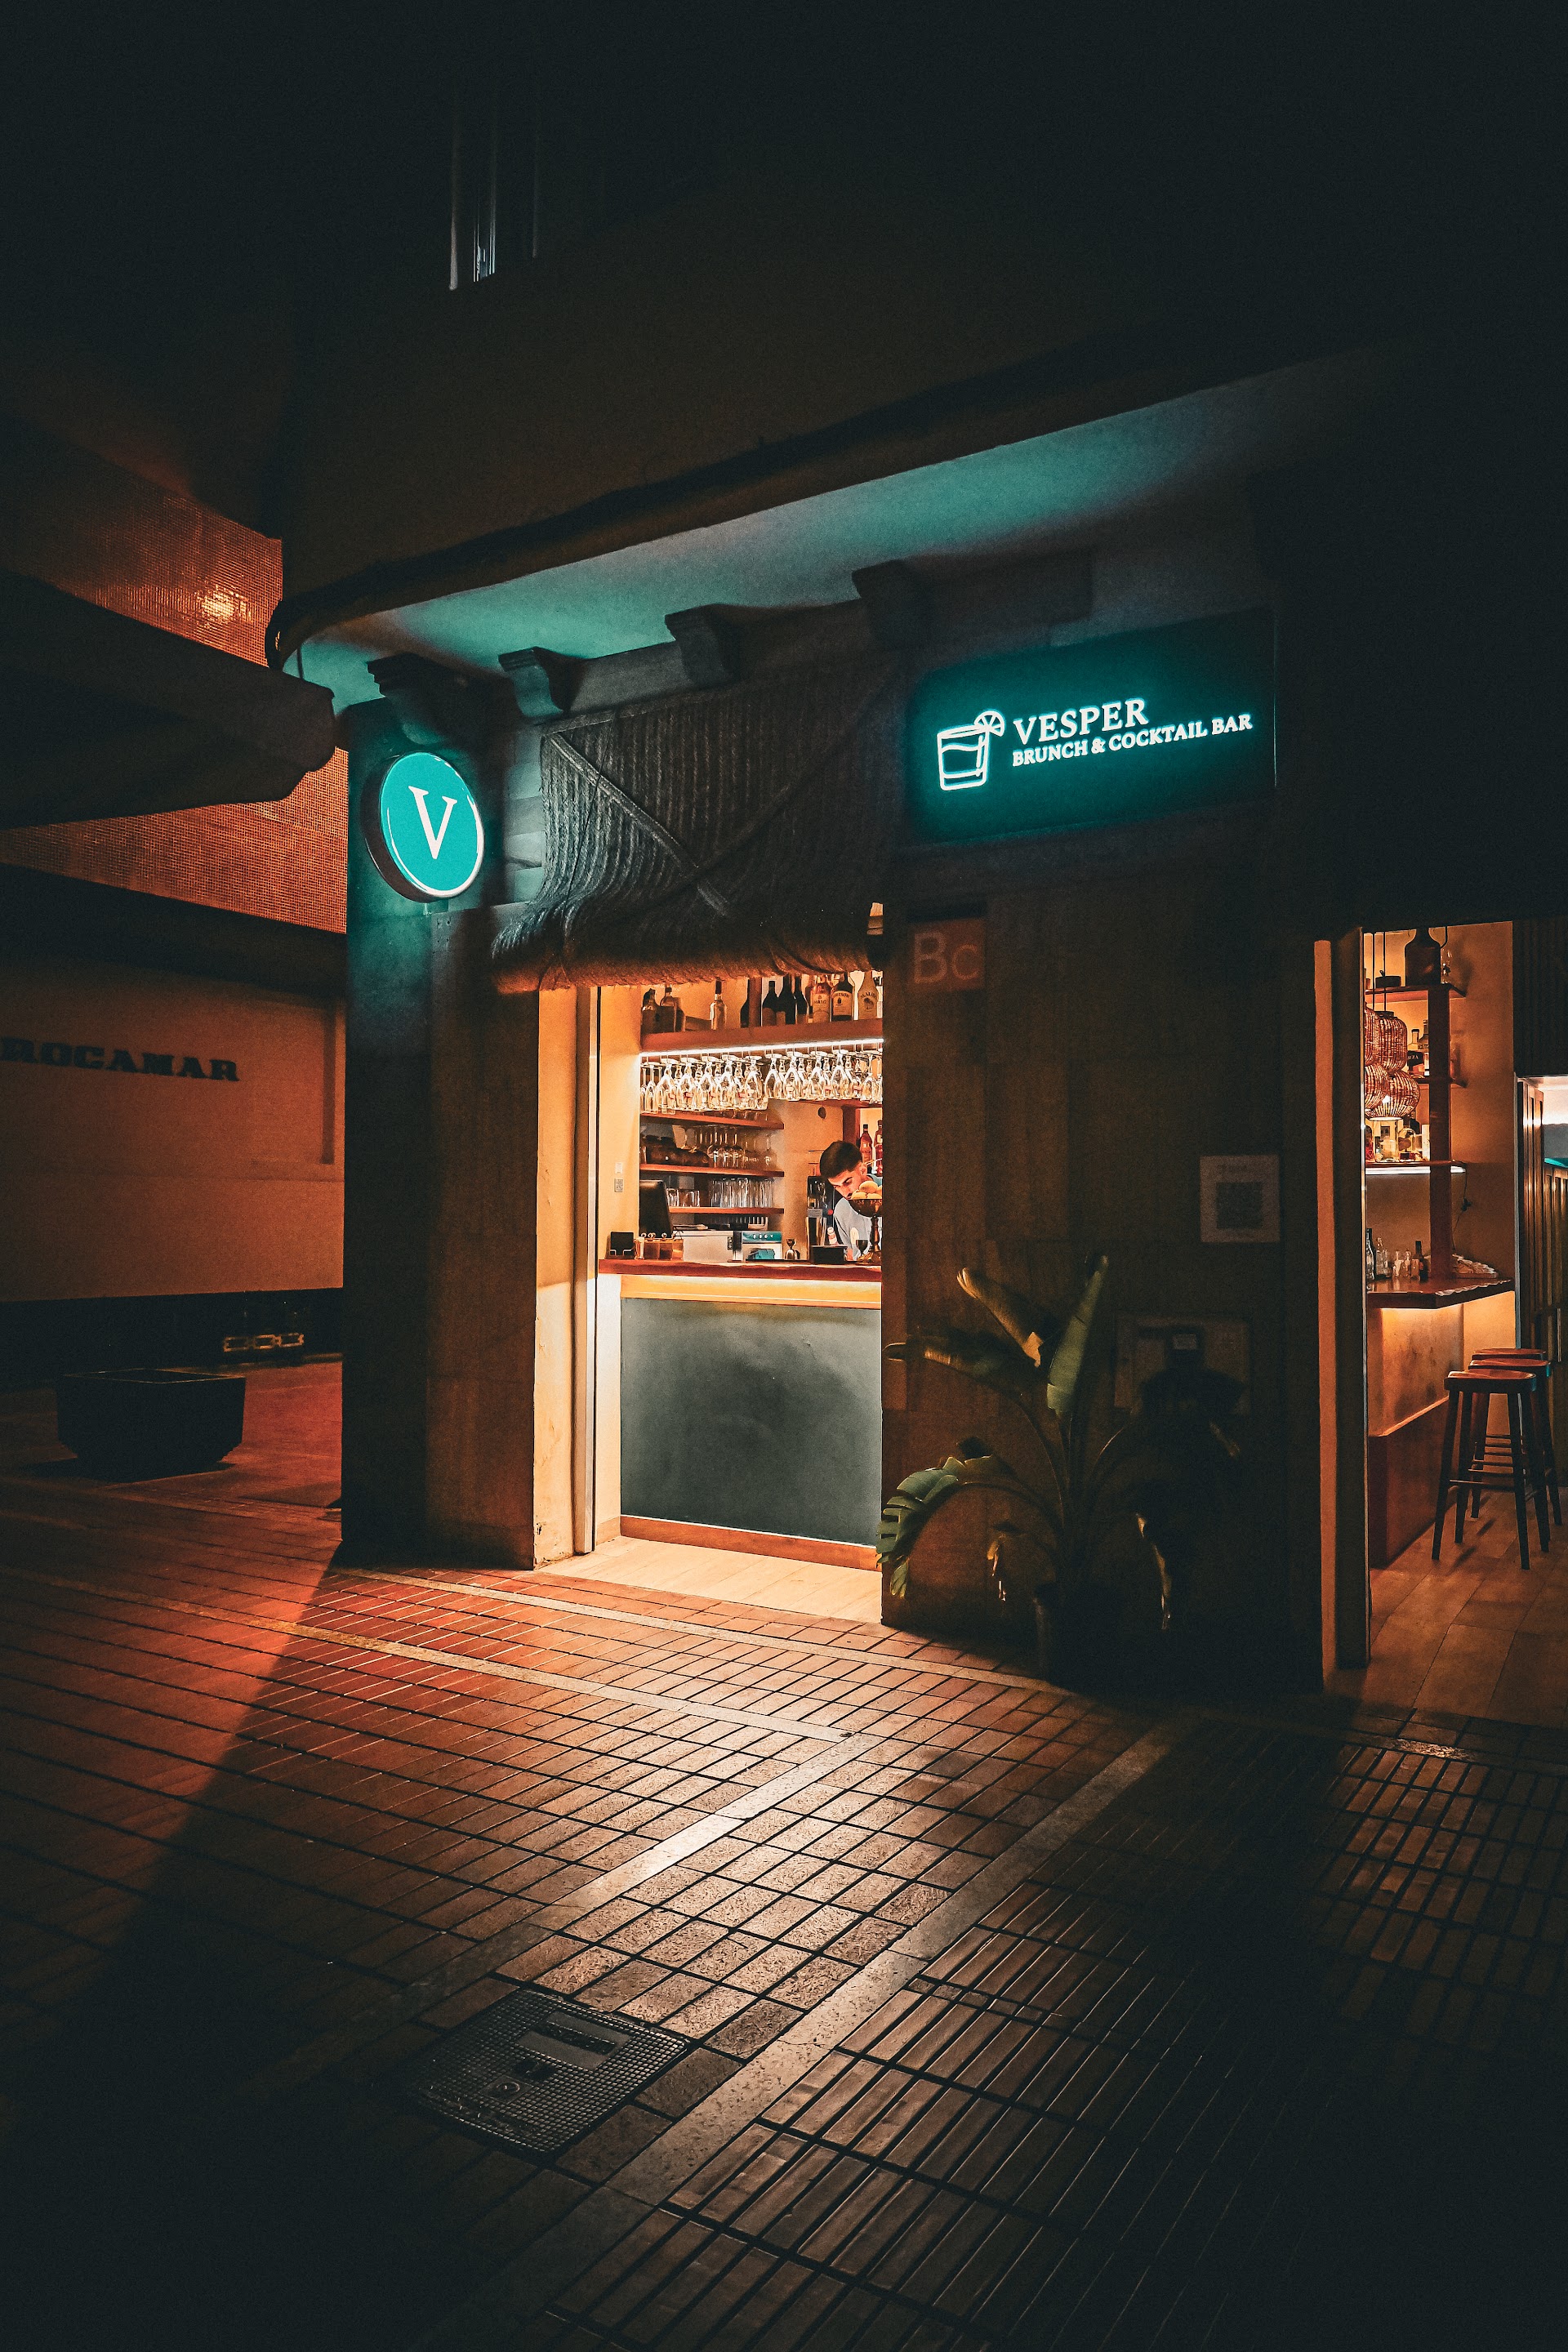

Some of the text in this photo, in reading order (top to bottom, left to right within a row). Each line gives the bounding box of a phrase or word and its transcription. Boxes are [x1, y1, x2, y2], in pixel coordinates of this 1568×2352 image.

[1012, 714, 1254, 767] BRUNCH & COCKTAIL BAR
[1013, 698, 1150, 746] VESPER
[408, 785, 458, 860] V
[0, 1036, 240, 1082] ROCAMAR
